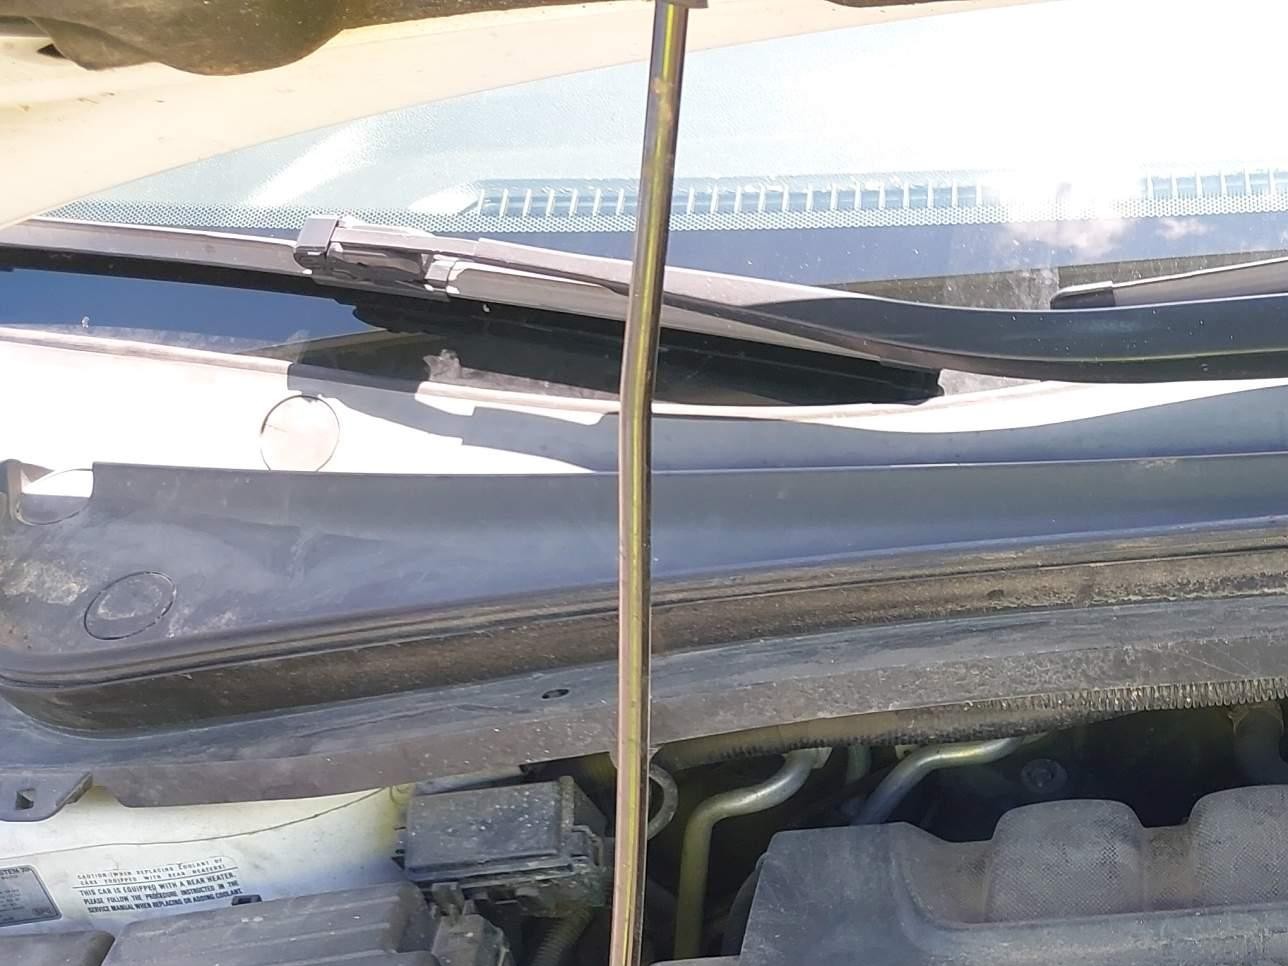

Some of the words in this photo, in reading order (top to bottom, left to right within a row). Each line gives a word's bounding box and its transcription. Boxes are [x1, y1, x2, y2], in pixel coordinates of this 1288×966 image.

[80, 888, 97, 897] THIS
[98, 887, 112, 896] CAR
[113, 886, 121, 895] IS
[122, 883, 157, 894] EQUIPPED
[158, 880, 178, 890] WITH
[187, 876, 206, 886] REAR
[83, 896, 104, 905] PLEASE
[107, 895, 130, 904] FOLLOW
[131, 893, 143, 901] THE
[180, 885, 215, 896] INSTRUCTED
[227, 879, 240, 888] THE
[88, 905, 111, 914] SERVICE
[110, 903, 136, 912] MANUAL
[134, 901, 152, 910] WHEN
[152, 896, 184, 908] REPLACING
[192, 892, 215, 903] ADDING
